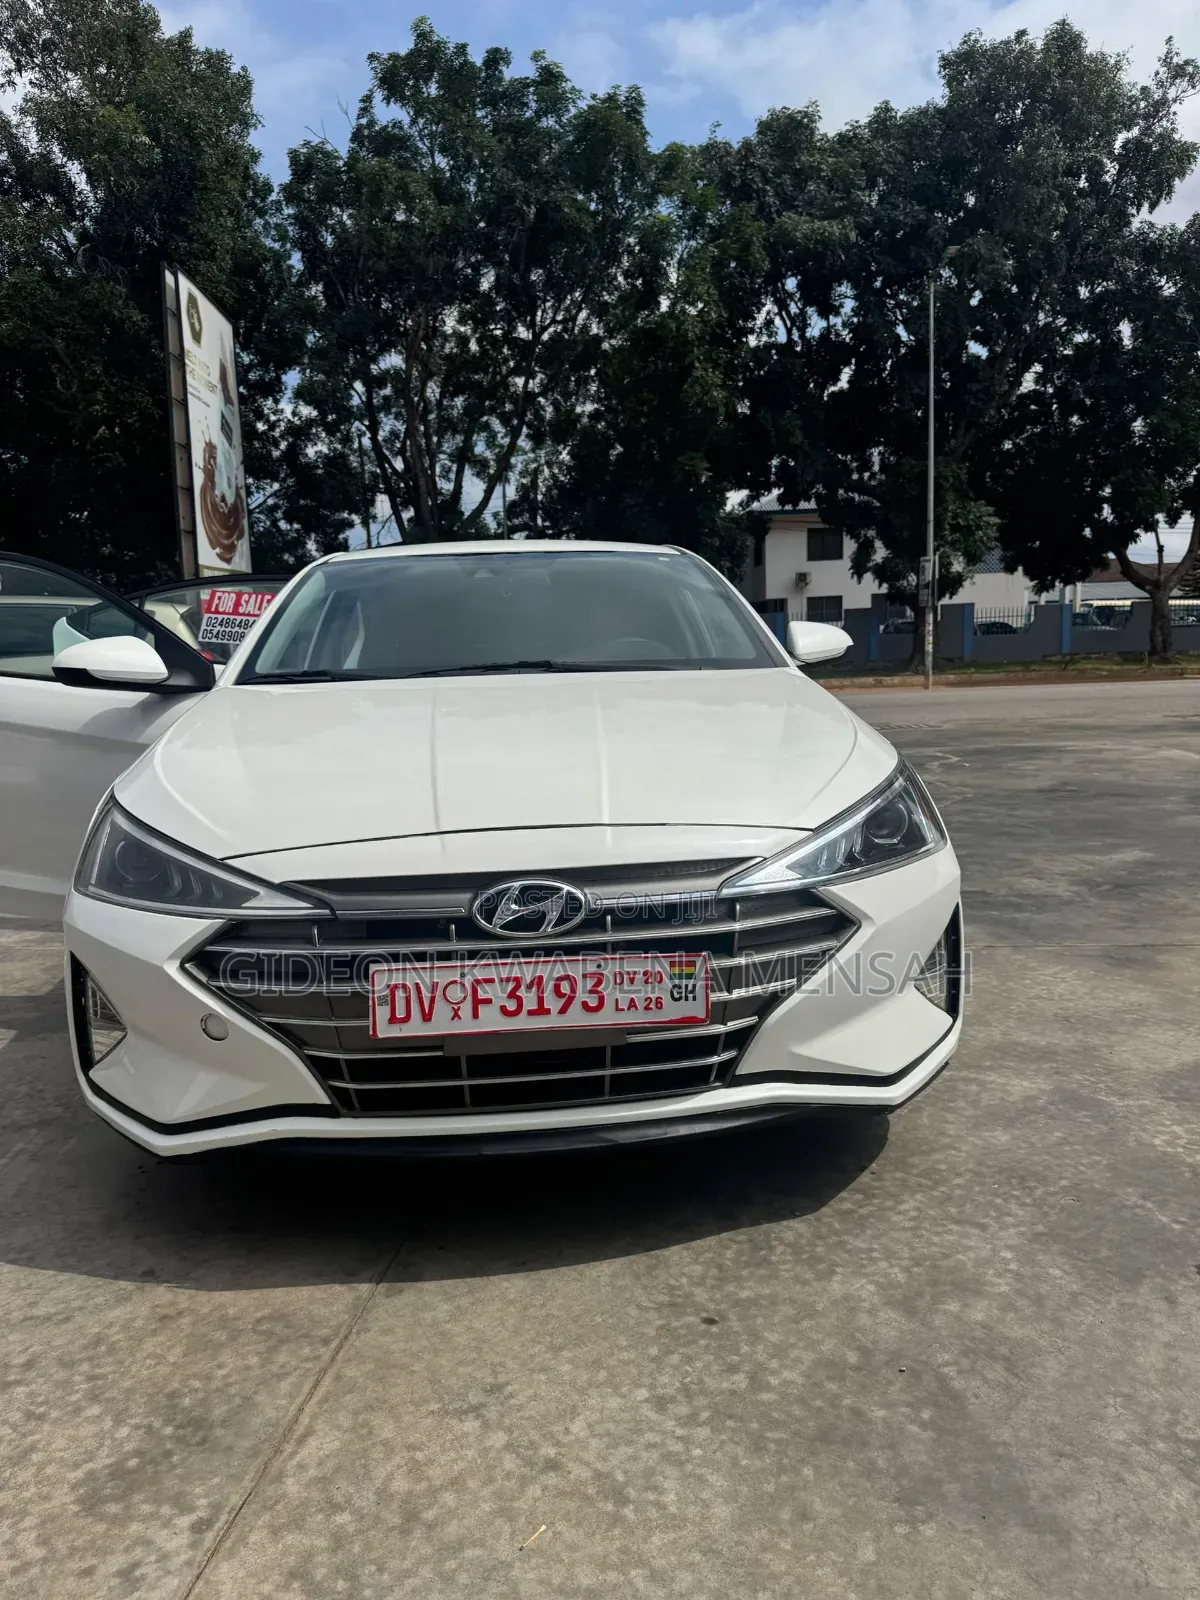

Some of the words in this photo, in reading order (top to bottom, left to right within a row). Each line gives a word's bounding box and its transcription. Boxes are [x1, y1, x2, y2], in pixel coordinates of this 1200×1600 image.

[211, 592, 236, 613] FOR
[239, 594, 272, 615] SALE
[614, 970, 637, 985] DV
[642, 969, 664, 984] 20
[387, 980, 439, 1024] DV
[471, 971, 606, 1020] F3193
[669, 983, 697, 1002] GH
[615, 996, 639, 1011] LA
[643, 996, 664, 1010] 26
